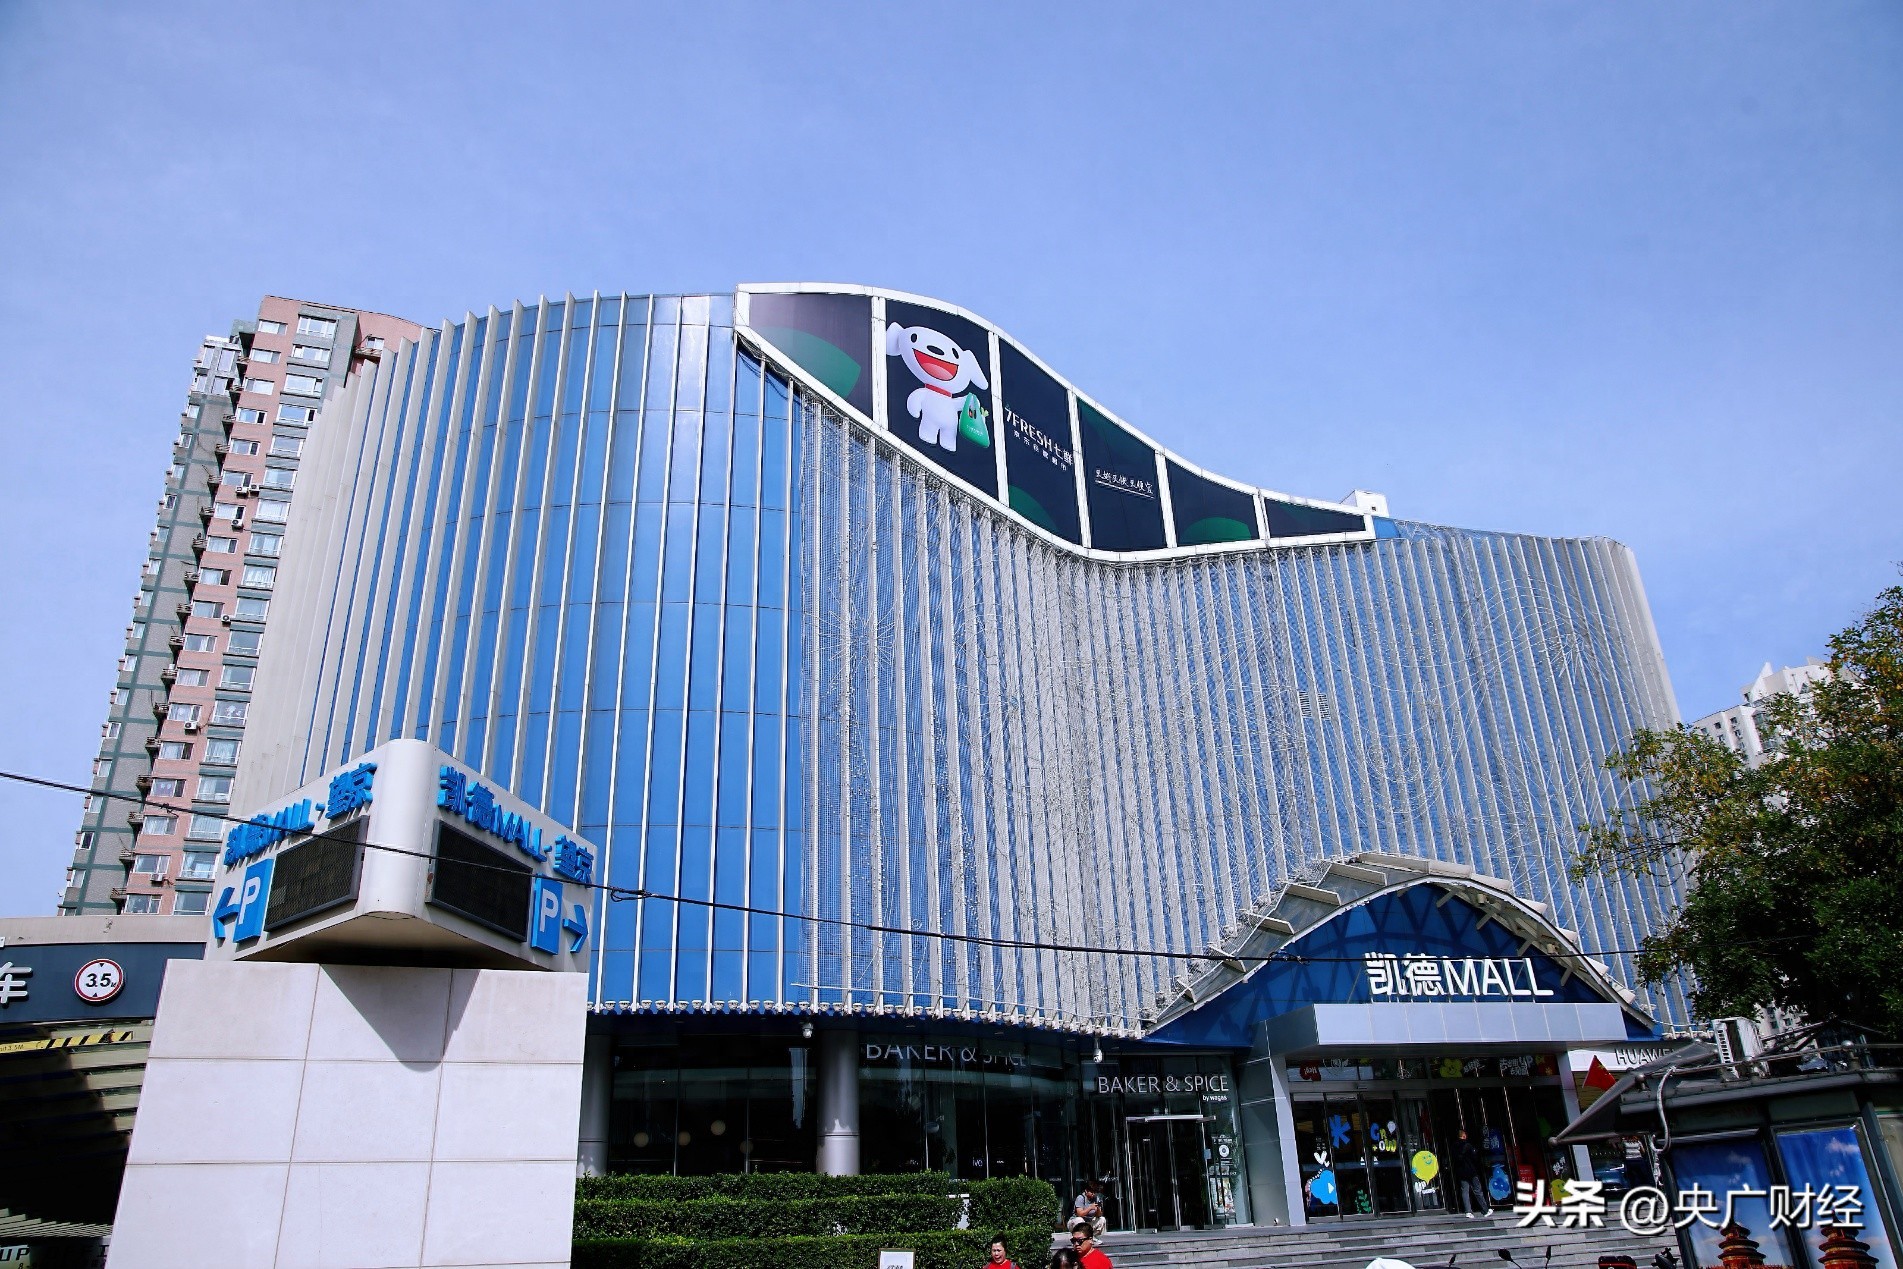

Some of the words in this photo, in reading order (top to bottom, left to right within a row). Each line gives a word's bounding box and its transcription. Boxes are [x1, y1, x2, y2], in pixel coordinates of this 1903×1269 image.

[238, 877, 261, 925] P
[539, 888, 559, 933] P
[1365, 952, 1554, 996] 凯德MALL
[1614, 1048, 1676, 1066] HUAWE
[1098, 1076, 1161, 1094] BAKER
[1165, 1075, 1180, 1092] &
[1184, 1075, 1229, 1092] SPICE
